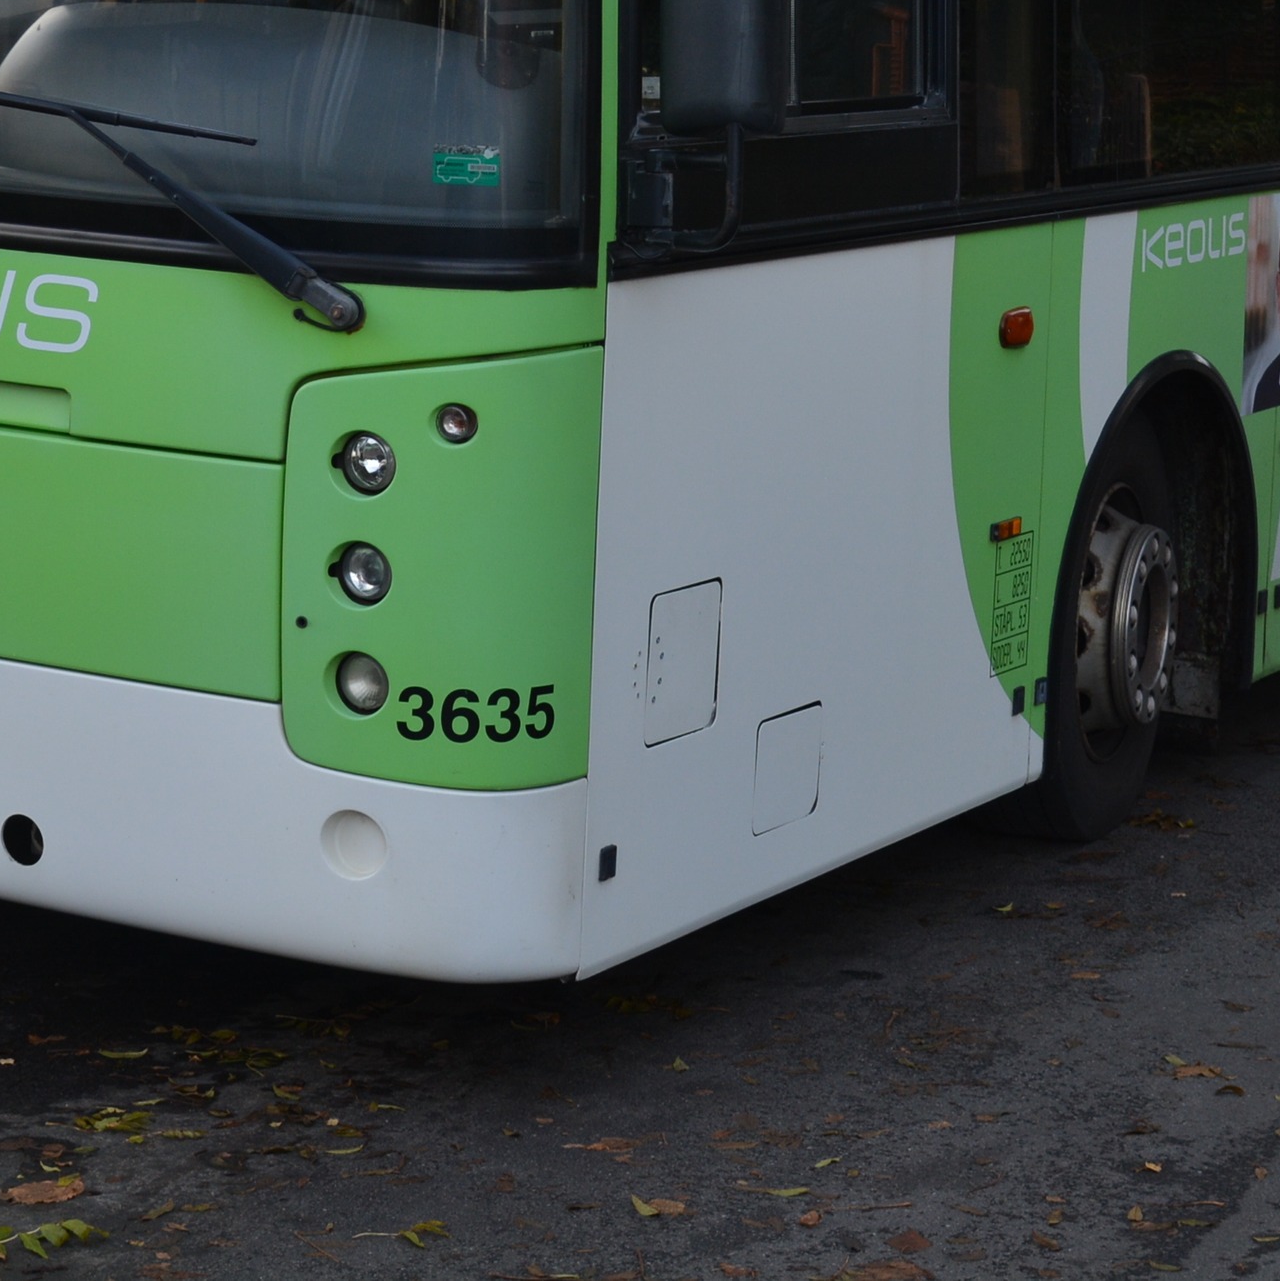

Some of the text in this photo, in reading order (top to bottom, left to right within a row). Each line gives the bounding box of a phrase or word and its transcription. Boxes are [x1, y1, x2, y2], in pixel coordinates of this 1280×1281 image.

[1010, 538, 1030, 566] 22550
[1012, 571, 1029, 598] 8250
[1018, 603, 1027, 629] 53
[396, 684, 555, 743] 3635
